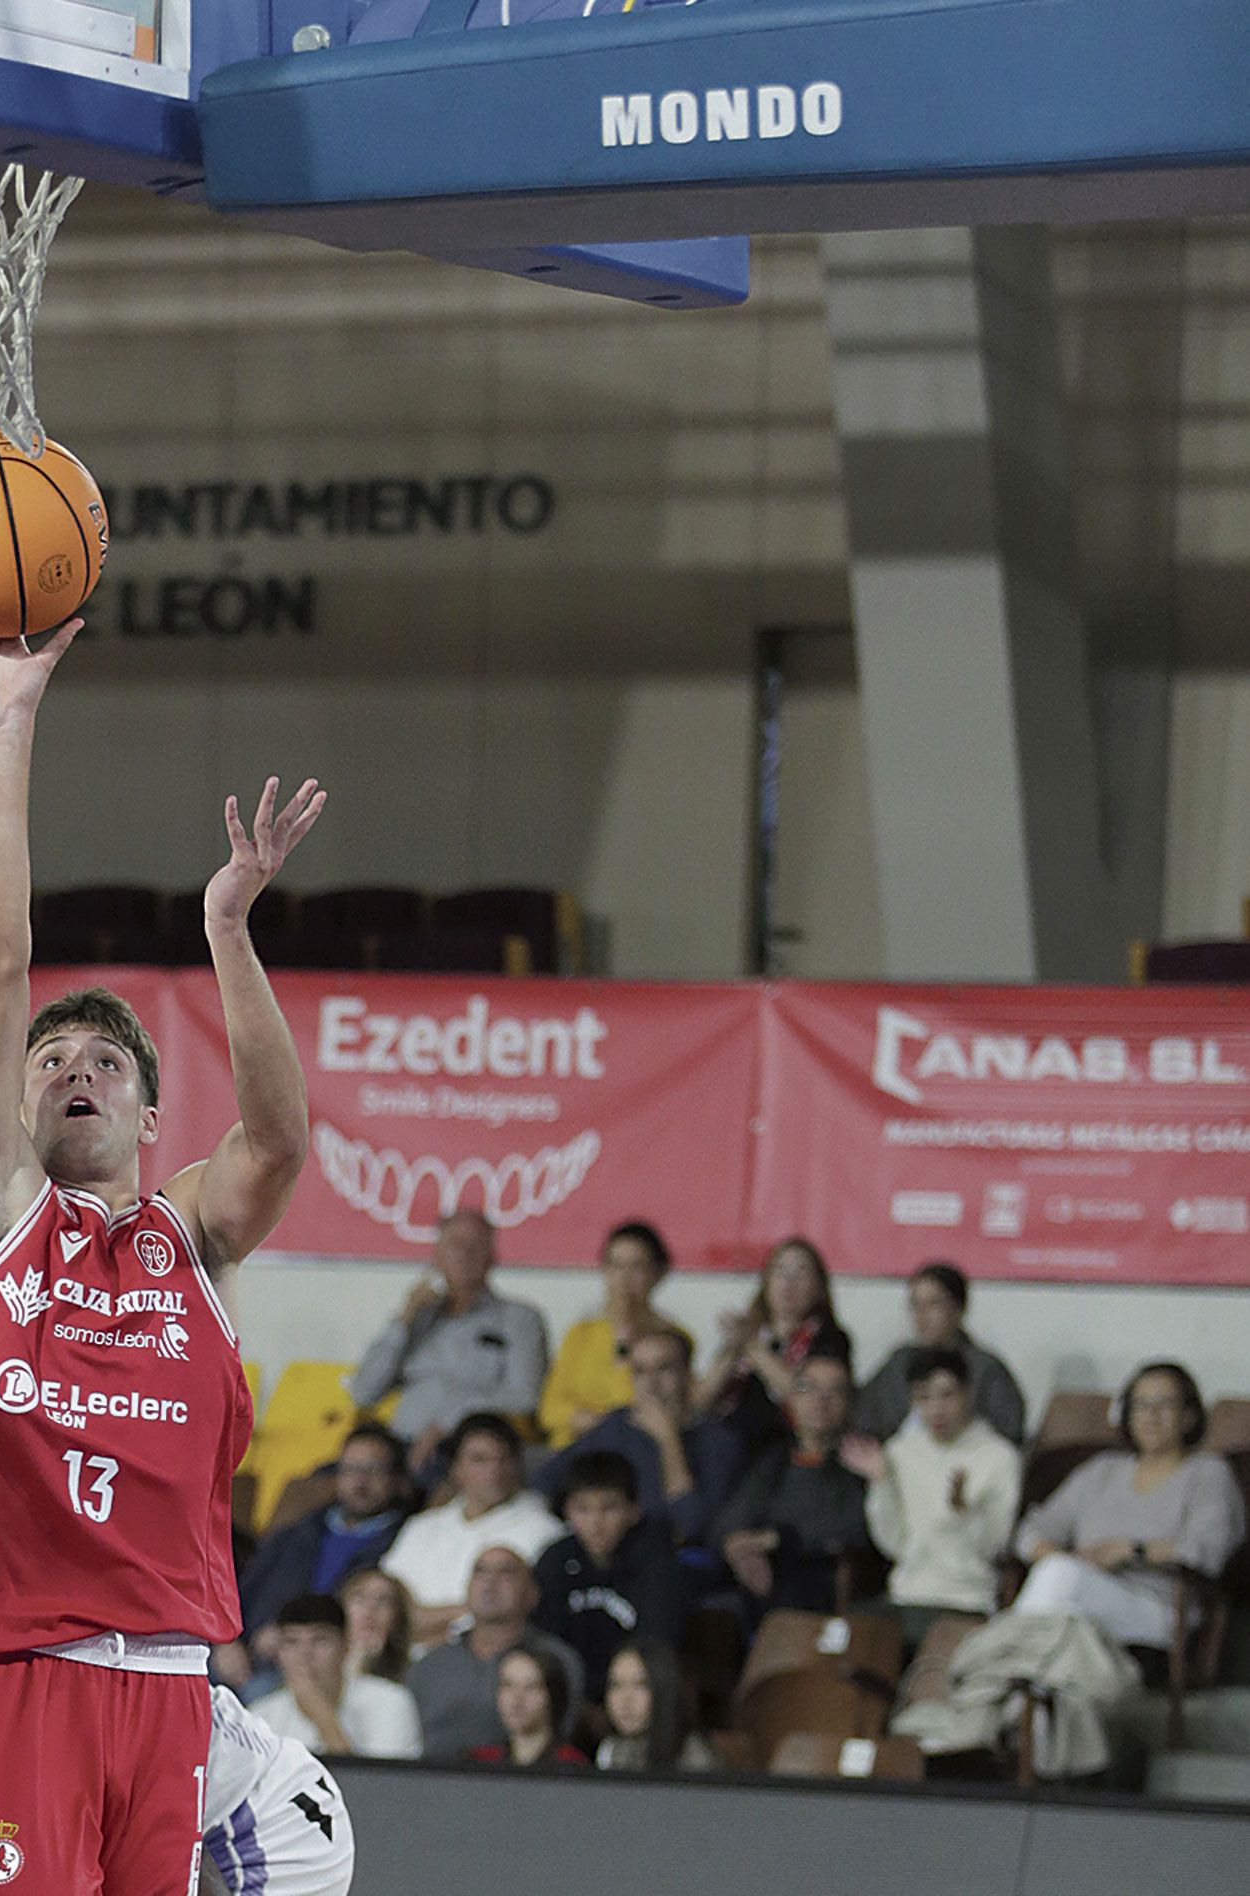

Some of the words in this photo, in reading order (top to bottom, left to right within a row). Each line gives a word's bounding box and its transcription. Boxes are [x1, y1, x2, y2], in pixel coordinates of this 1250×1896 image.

[601, 81, 843, 147] MONDO
[102, 475, 555, 538] UNTAMIENTO
[318, 994, 608, 1080] Ezedent
[53, 1278, 112, 1316] CAJA
[115, 1289, 187, 1317] RURAL
[41, 1380, 188, 1424] E.Leclerc
[45, 1408, 87, 1430] LEÓN
[61, 1449, 119, 1524] 13
